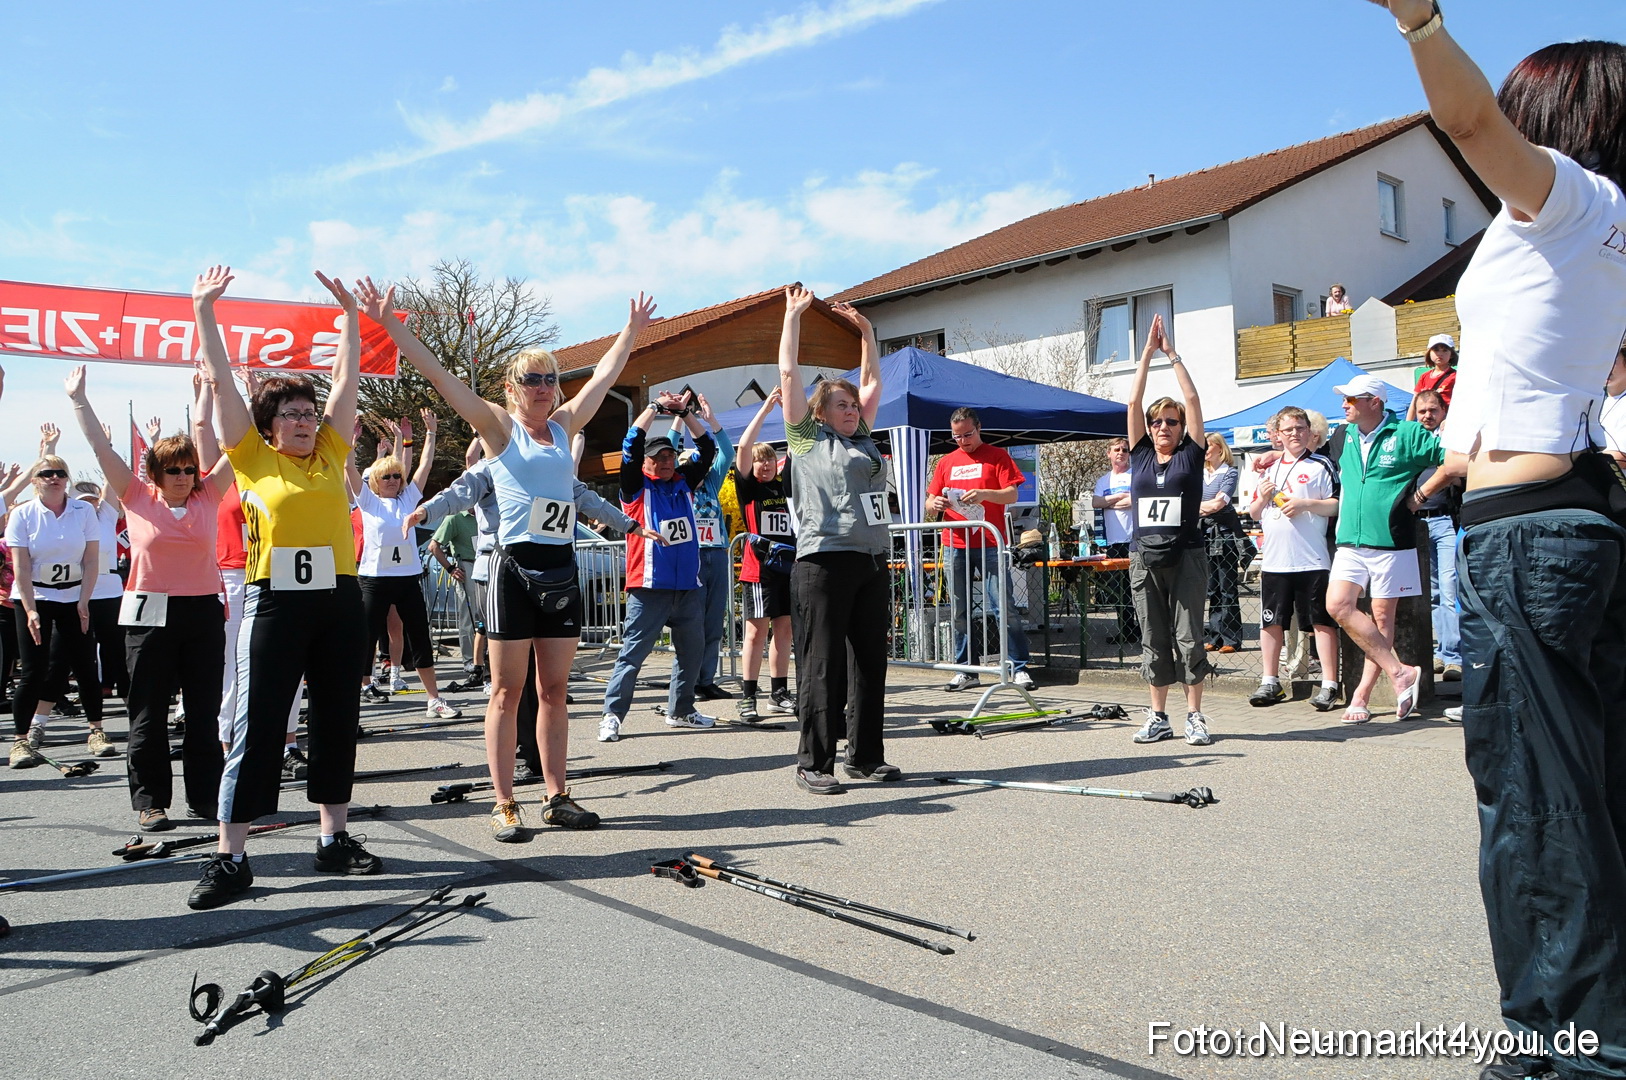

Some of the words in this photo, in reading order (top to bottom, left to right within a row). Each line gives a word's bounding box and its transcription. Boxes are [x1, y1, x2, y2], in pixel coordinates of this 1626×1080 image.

[541, 502, 570, 534] 24
[869, 494, 885, 521] 57
[1147, 499, 1170, 522] 47
[667, 521, 688, 542] 29
[767, 513, 788, 533] 115
[697, 527, 714, 542] 74
[391, 546, 402, 564] 4
[51, 563, 71, 582] 21
[294, 549, 313, 585] 6
[135, 594, 148, 622] 7
